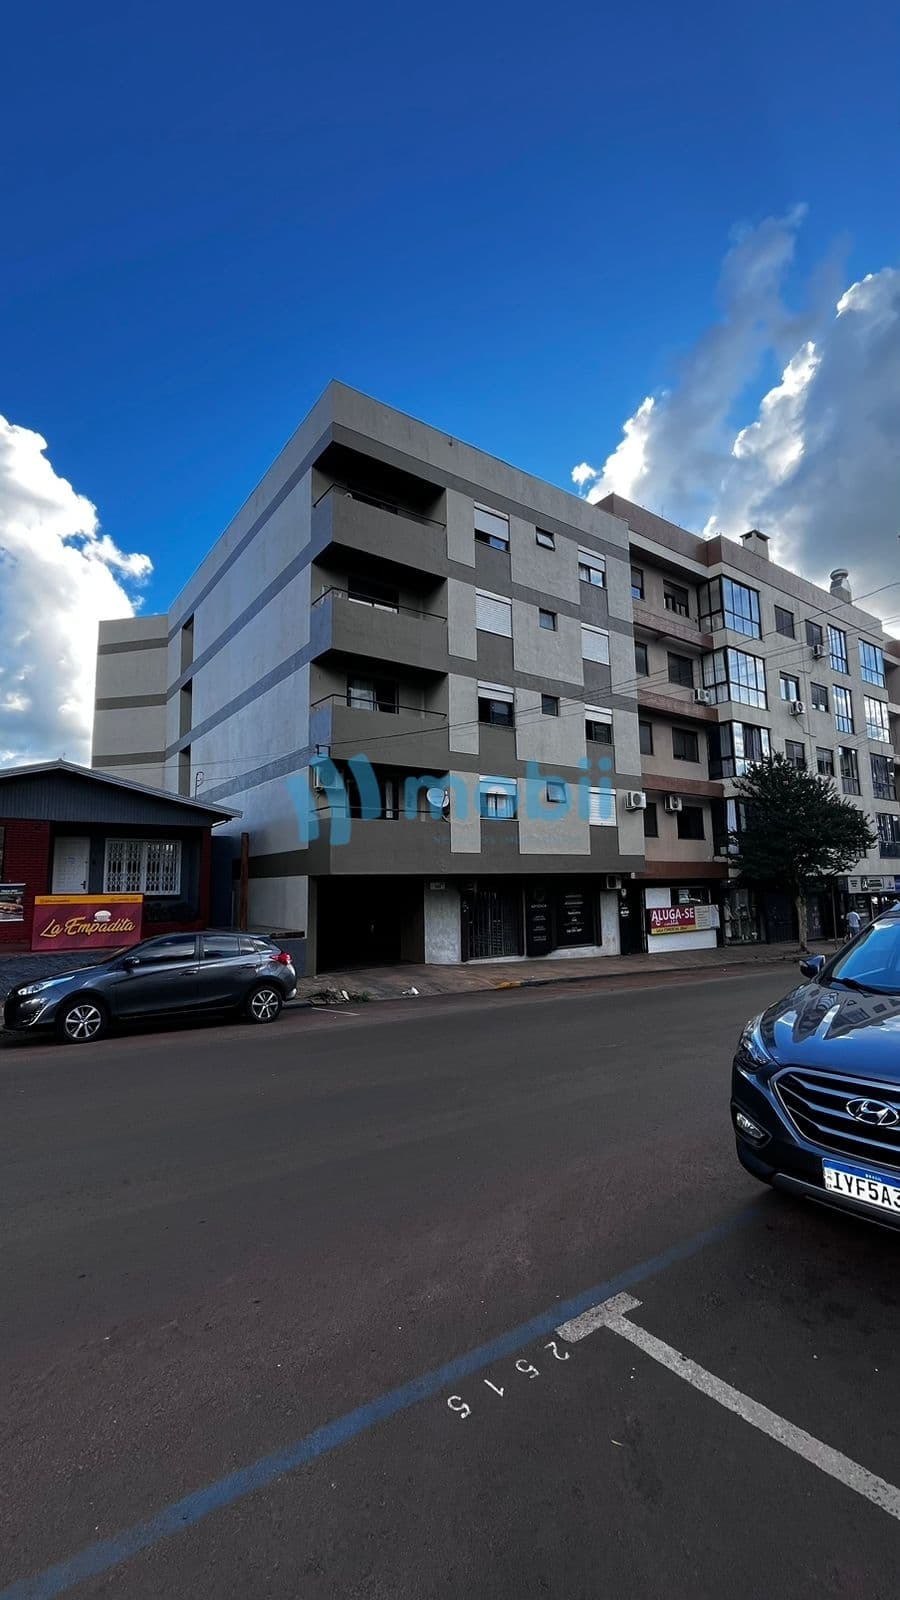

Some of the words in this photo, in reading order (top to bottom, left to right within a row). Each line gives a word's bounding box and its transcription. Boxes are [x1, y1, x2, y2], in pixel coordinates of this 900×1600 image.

[651, 908, 695, 922] ALUGA-SE
[40, 919, 64, 938] La
[64, 916, 136, 936] Empadita
